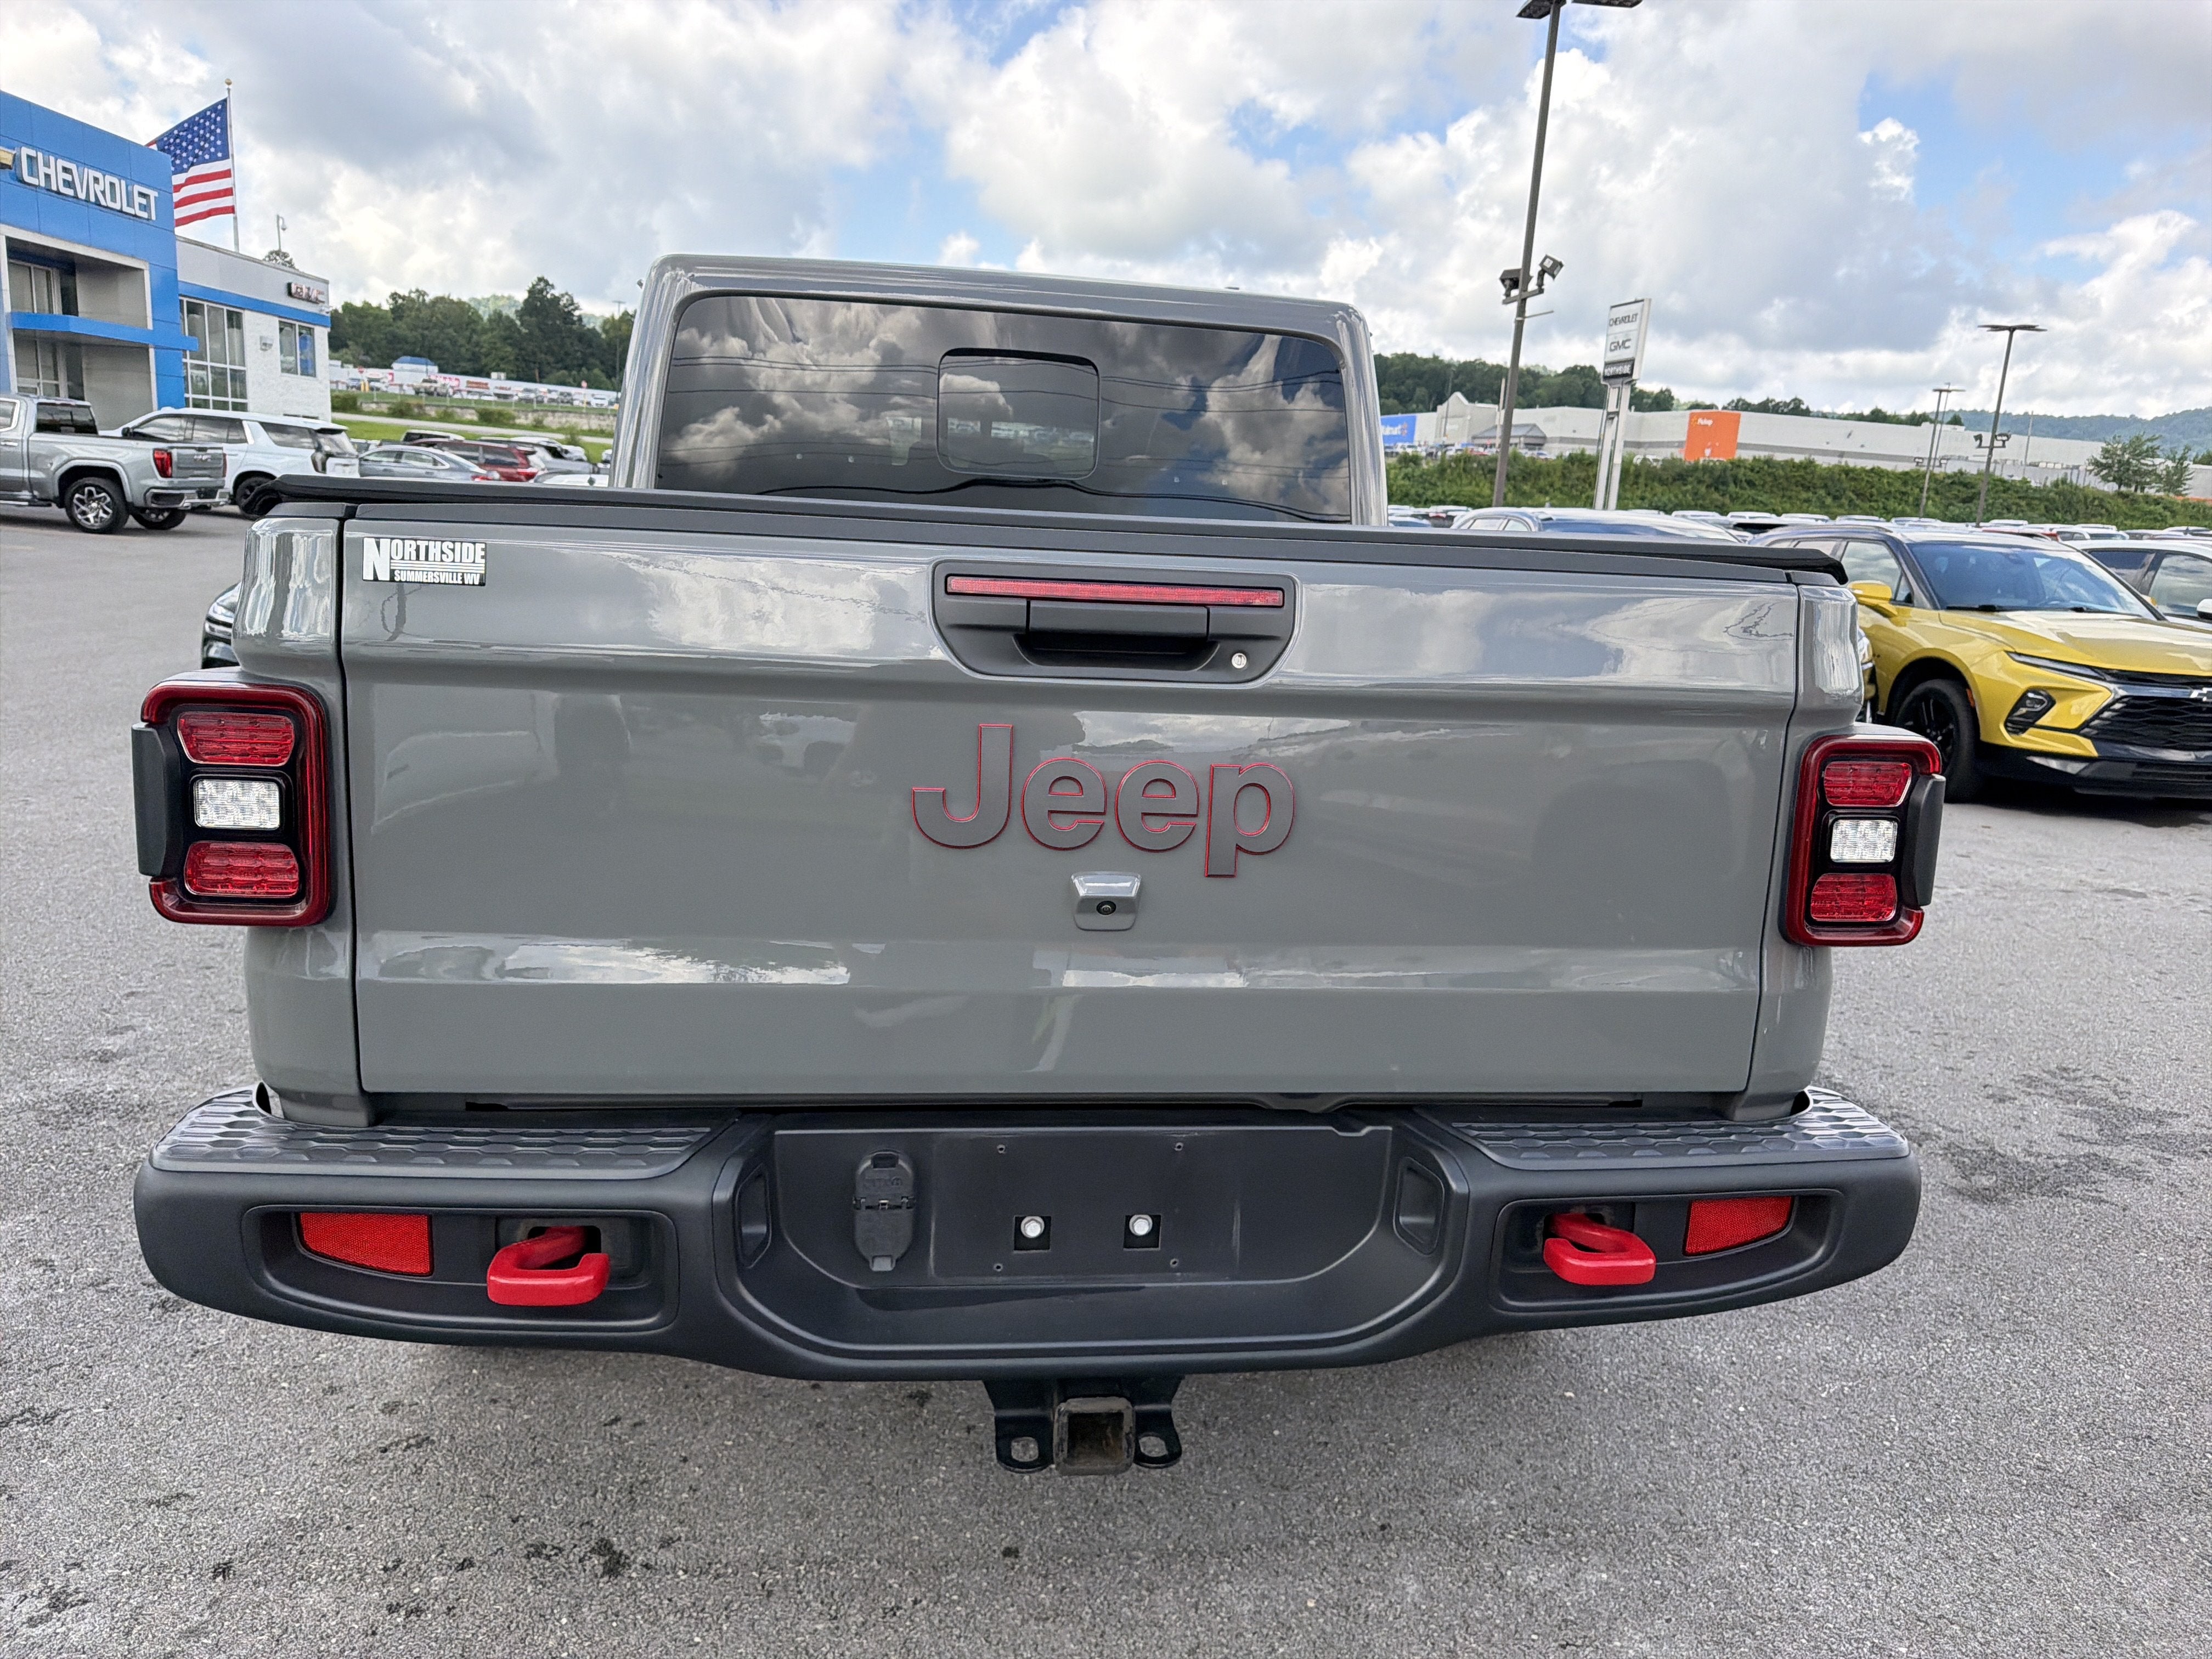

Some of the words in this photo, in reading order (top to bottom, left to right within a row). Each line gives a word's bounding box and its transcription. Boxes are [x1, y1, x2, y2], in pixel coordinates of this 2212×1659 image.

[21, 146, 159, 221] CHEVROLET
[1609, 314, 1638, 326] CHEVROLET
[1610, 339, 1631, 352] GMC
[363, 537, 486, 581] NORTHSIDE
[394, 569, 462, 583] SUMMERSVILLE
[464, 573, 480, 585] WV
[912, 724, 1296, 878] Jeep
